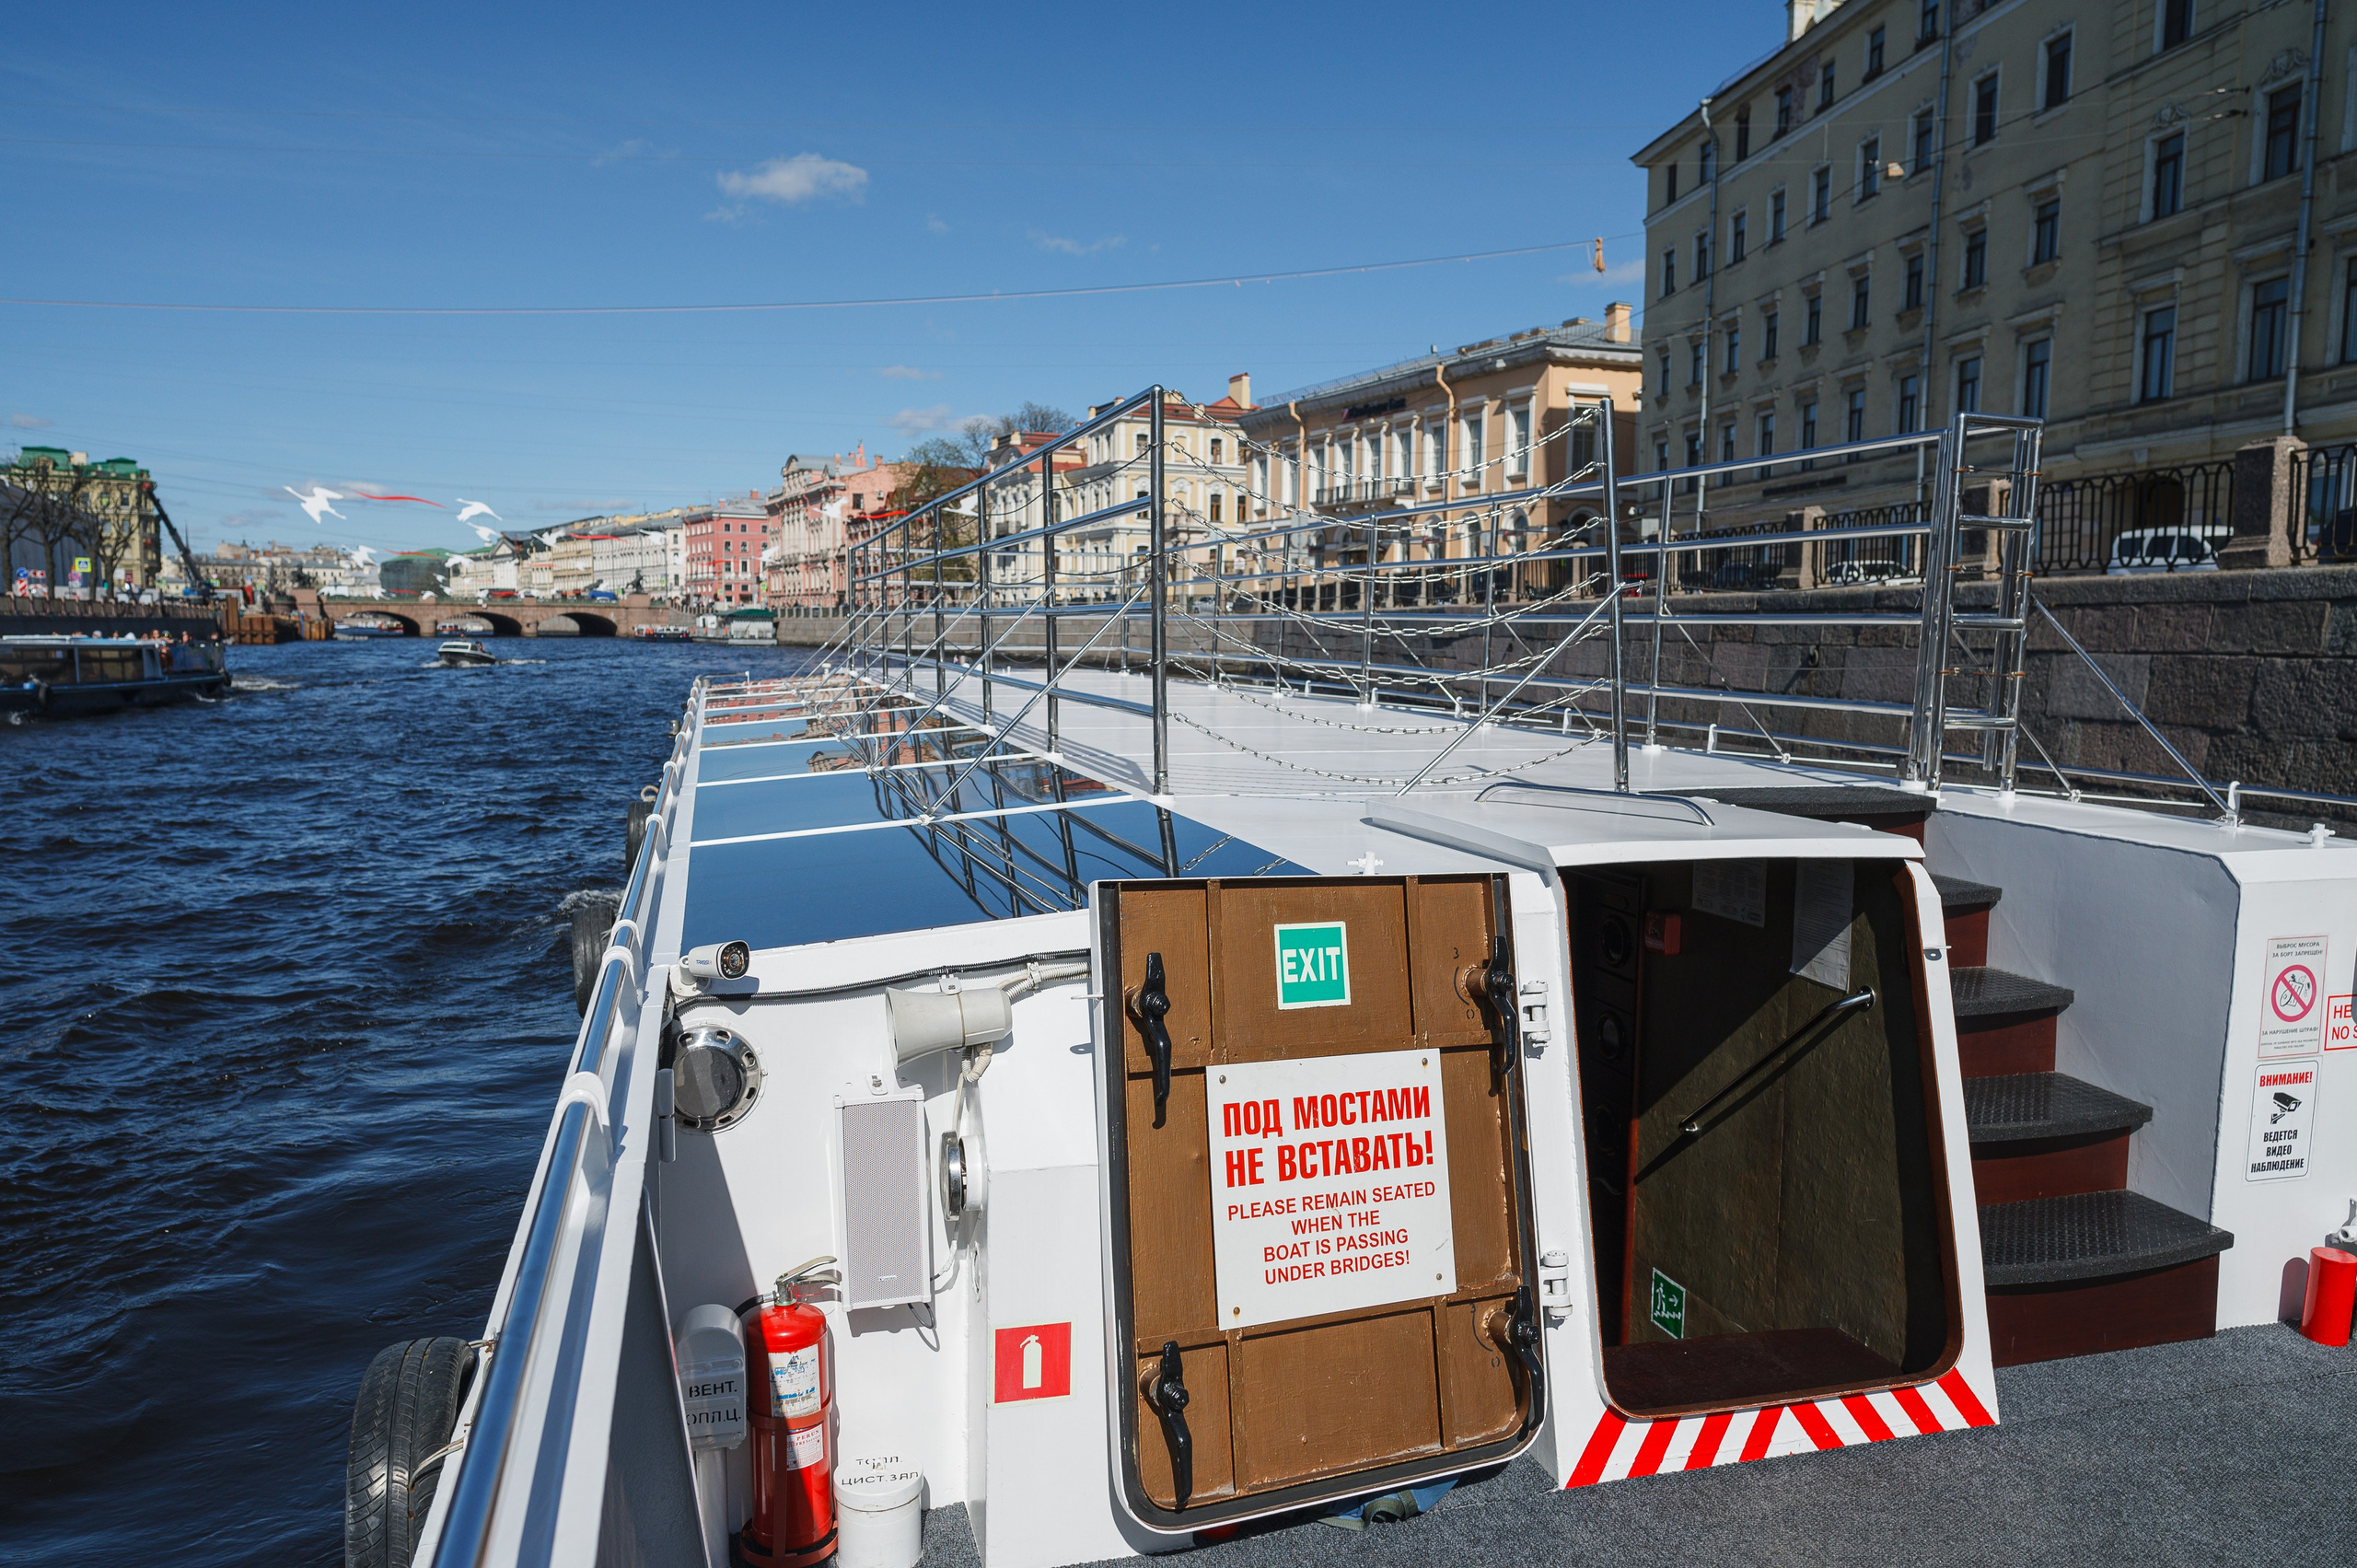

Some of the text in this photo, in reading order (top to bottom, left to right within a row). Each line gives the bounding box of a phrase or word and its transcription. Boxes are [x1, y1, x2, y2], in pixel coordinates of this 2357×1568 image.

[1283, 947, 1341, 983] EXIT
[2331, 1026, 2350, 1040] NO
[2259, 1071, 2313, 1087] ВНИМАНИЕ!
[1223, 1086, 1431, 1139] ПОД МОСТАМИ
[2263, 1129, 2298, 1143] ВЕДЕТСЯ
[1225, 1130, 1434, 1188] НЕ ВСТАВАТЬ!
[2266, 1144, 2292, 1157] ВИДЕО
[2250, 1158, 2305, 1173] НАБЛЮДЕНИЕ
[1227, 1181, 1435, 1221] PLEASE REMAIN SEATED
[1291, 1210, 1380, 1236] WHEN THE
[1263, 1228, 1409, 1262] BOAT IS PASSING
[1264, 1249, 1410, 1284] UNDER BRIDGES!
[689, 1380, 737, 1398] ВЕНТ.
